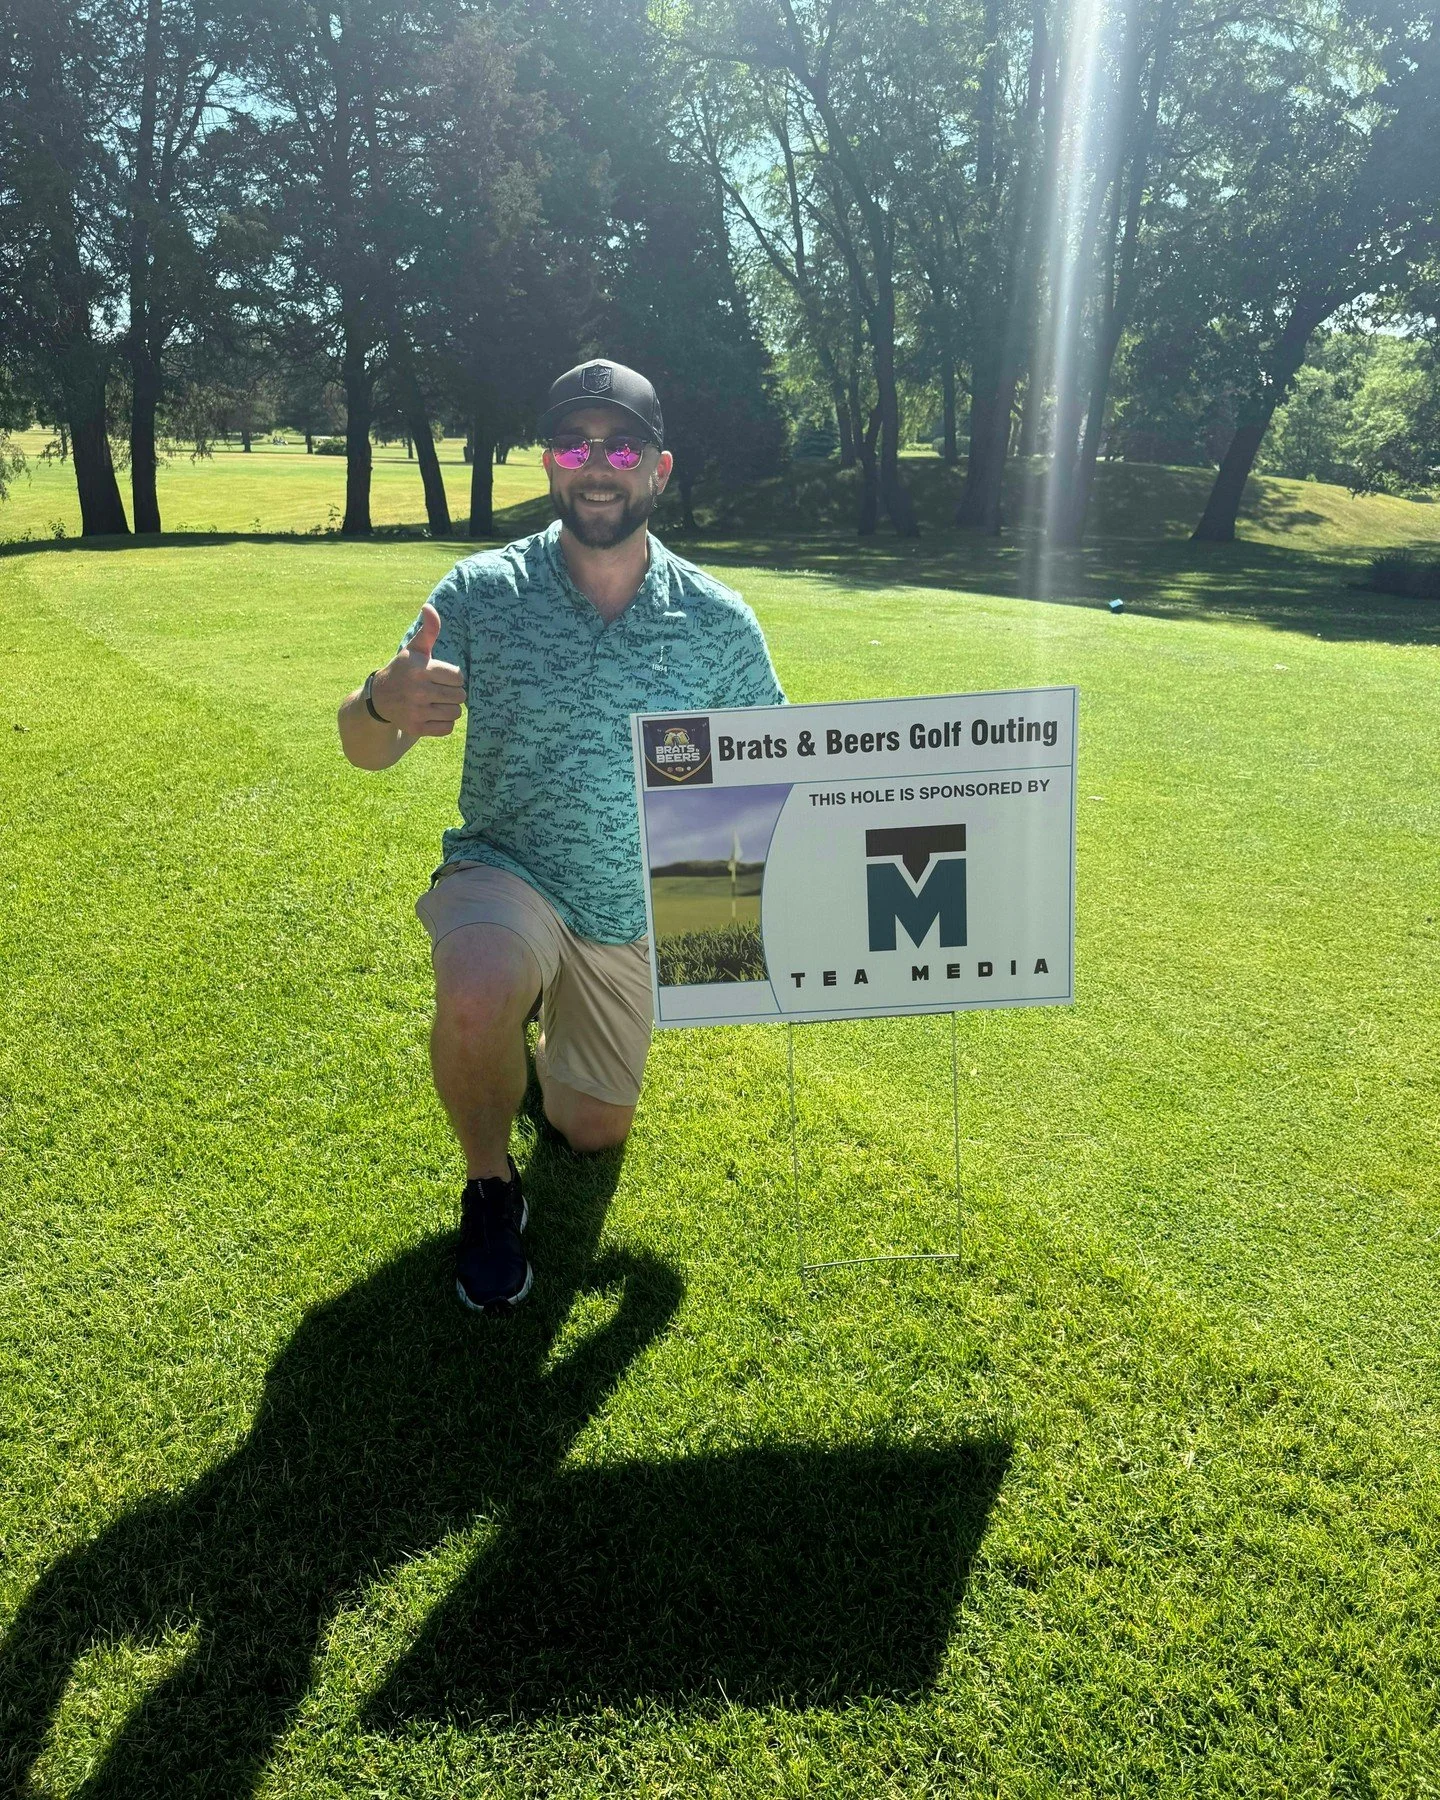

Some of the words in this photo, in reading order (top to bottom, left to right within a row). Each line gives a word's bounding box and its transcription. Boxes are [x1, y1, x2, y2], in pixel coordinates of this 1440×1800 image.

[655, 744, 695, 755] BRATS
[718, 734, 788, 761] Brats
[796, 730, 817, 757] &
[826, 729, 900, 755] Beers
[909, 721, 962, 749] Golf
[971, 716, 1058, 747] Outing
[656, 752, 701, 763] BEERS
[809, 792, 846, 807] THIS
[851, 789, 895, 804] HOLE
[900, 788, 915, 801] IS
[919, 781, 1023, 800] SPONSORED
[1027, 779, 1050, 793] BY
[791, 968, 869, 988] TEA
[911, 958, 1049, 981] MEDIA
